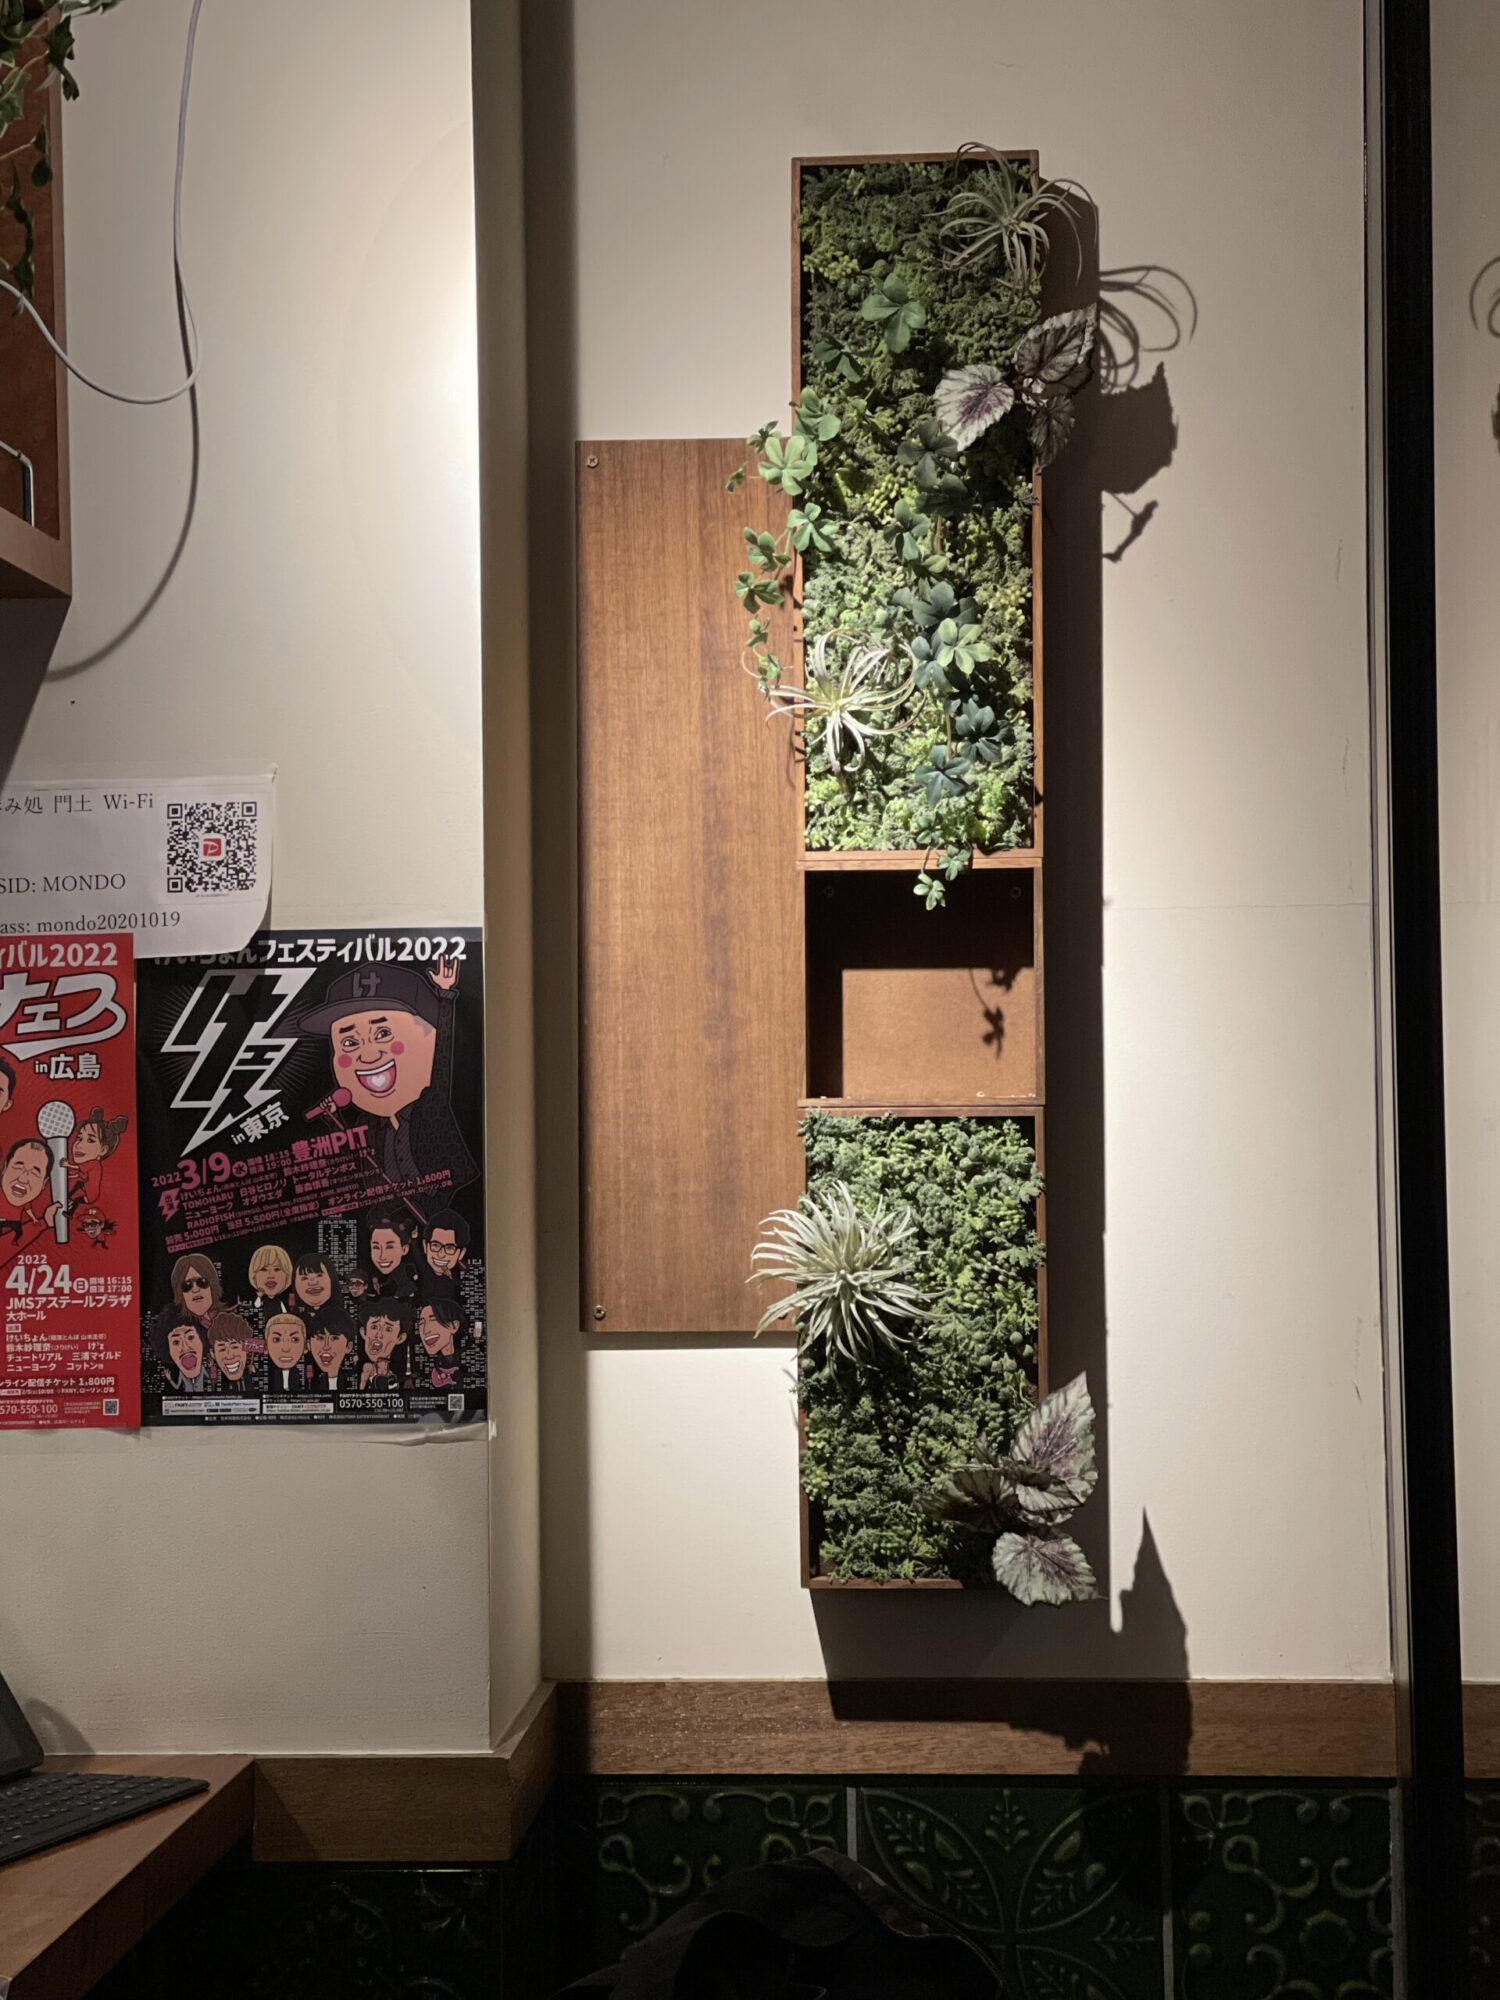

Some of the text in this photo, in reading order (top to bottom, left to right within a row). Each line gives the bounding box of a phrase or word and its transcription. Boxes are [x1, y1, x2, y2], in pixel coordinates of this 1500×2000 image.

[0, 793, 154, 814] み処 門土 Wi-Fi
[43, 873, 126, 892] MONDO
[37, 911, 181, 932] mondo20201019
[152, 1172, 182, 1187] 2022
[177, 1152, 231, 1190] 3/9
[18, 1254, 47, 1264] 2022
[5, 1264, 72, 1295] 4/24
[107, 1276, 132, 1285] 16:15
[107, 1284, 132, 1293] 17:00
[6, 1294, 132, 1310] JMSアステールプラザ
[6, 1310, 46, 1321] 大ホール
[7, 1353, 63, 1362] チュートリアル
[7, 1363, 56, 1372] ニューヨーク
[78, 1376, 115, 1386] 1,800円
[339, 1398, 404, 1408] 0570-550-100
